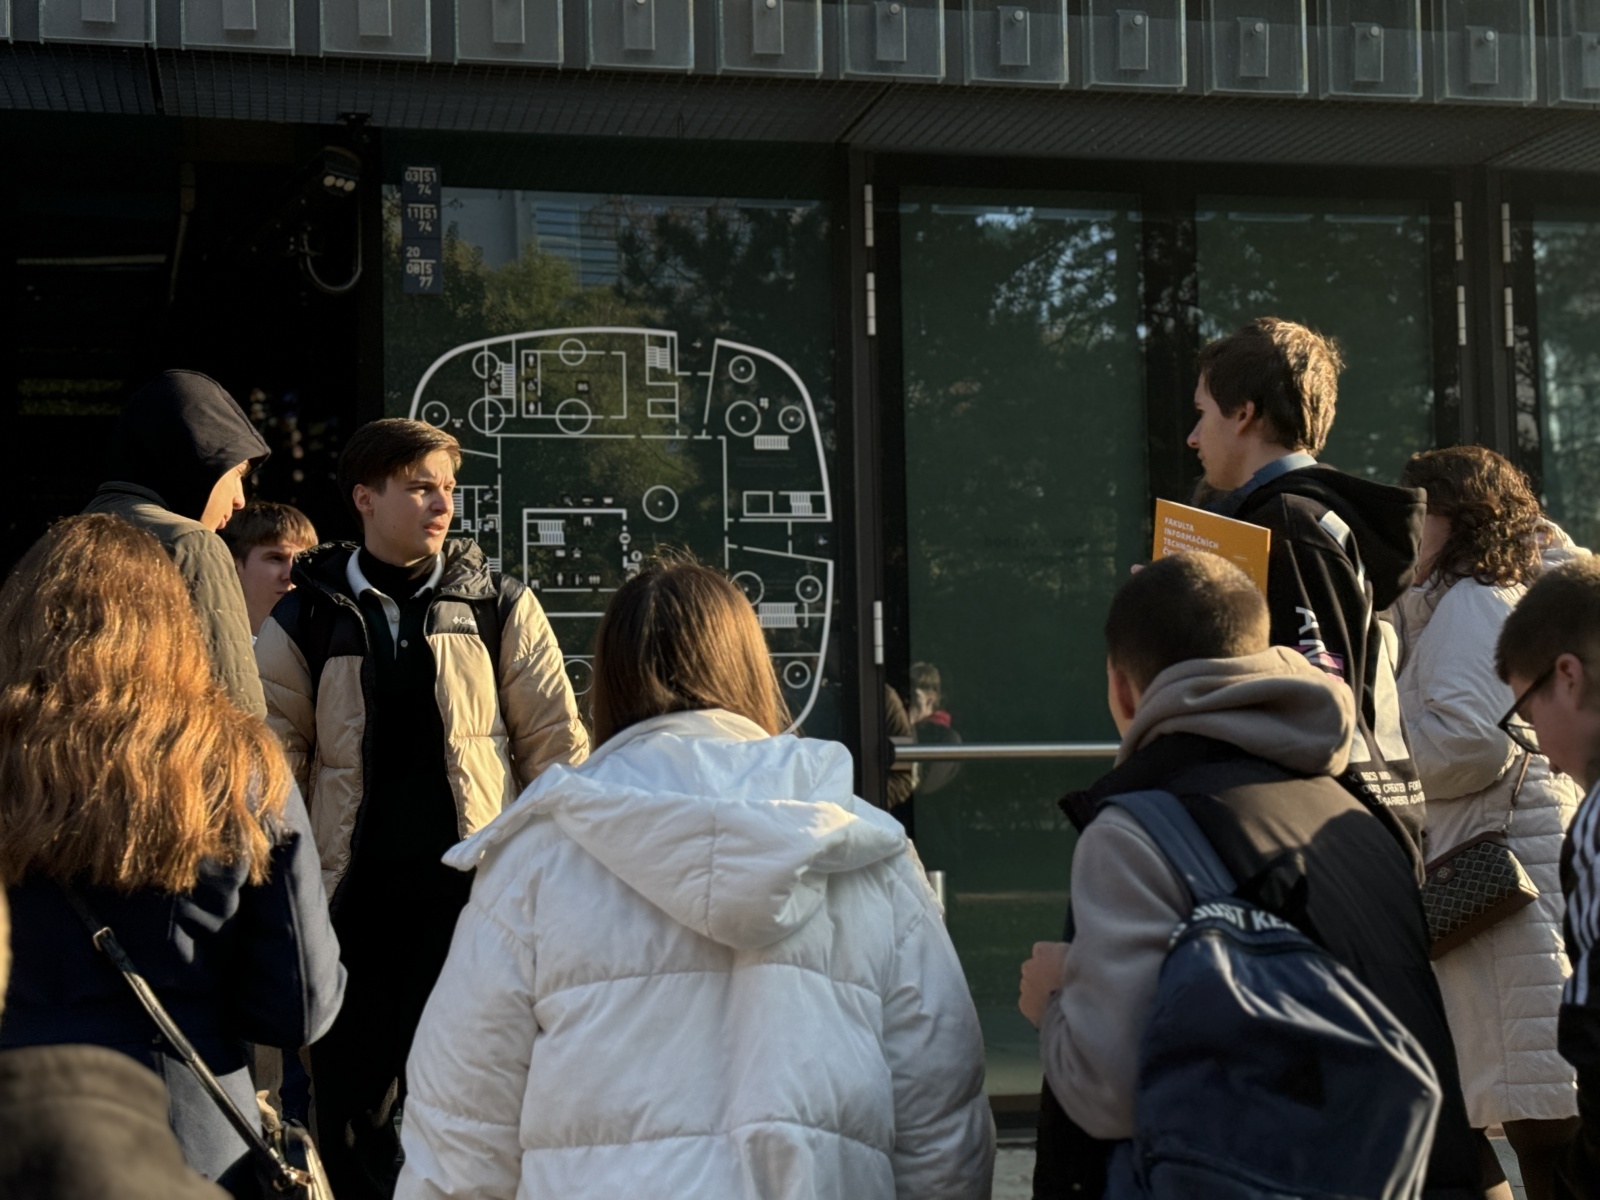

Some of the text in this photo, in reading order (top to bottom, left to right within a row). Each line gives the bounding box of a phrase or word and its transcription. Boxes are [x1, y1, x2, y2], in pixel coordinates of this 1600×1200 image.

[417, 184, 432, 195] 74
[418, 221, 433, 232] 74
[406, 246, 421, 258] 20
[419, 276, 433, 288] 77
[1164, 516, 1195, 532] FAKULTA
[1163, 527, 1219, 550] INFORMAČNÍCH
[1192, 903, 1245, 930] JUST
